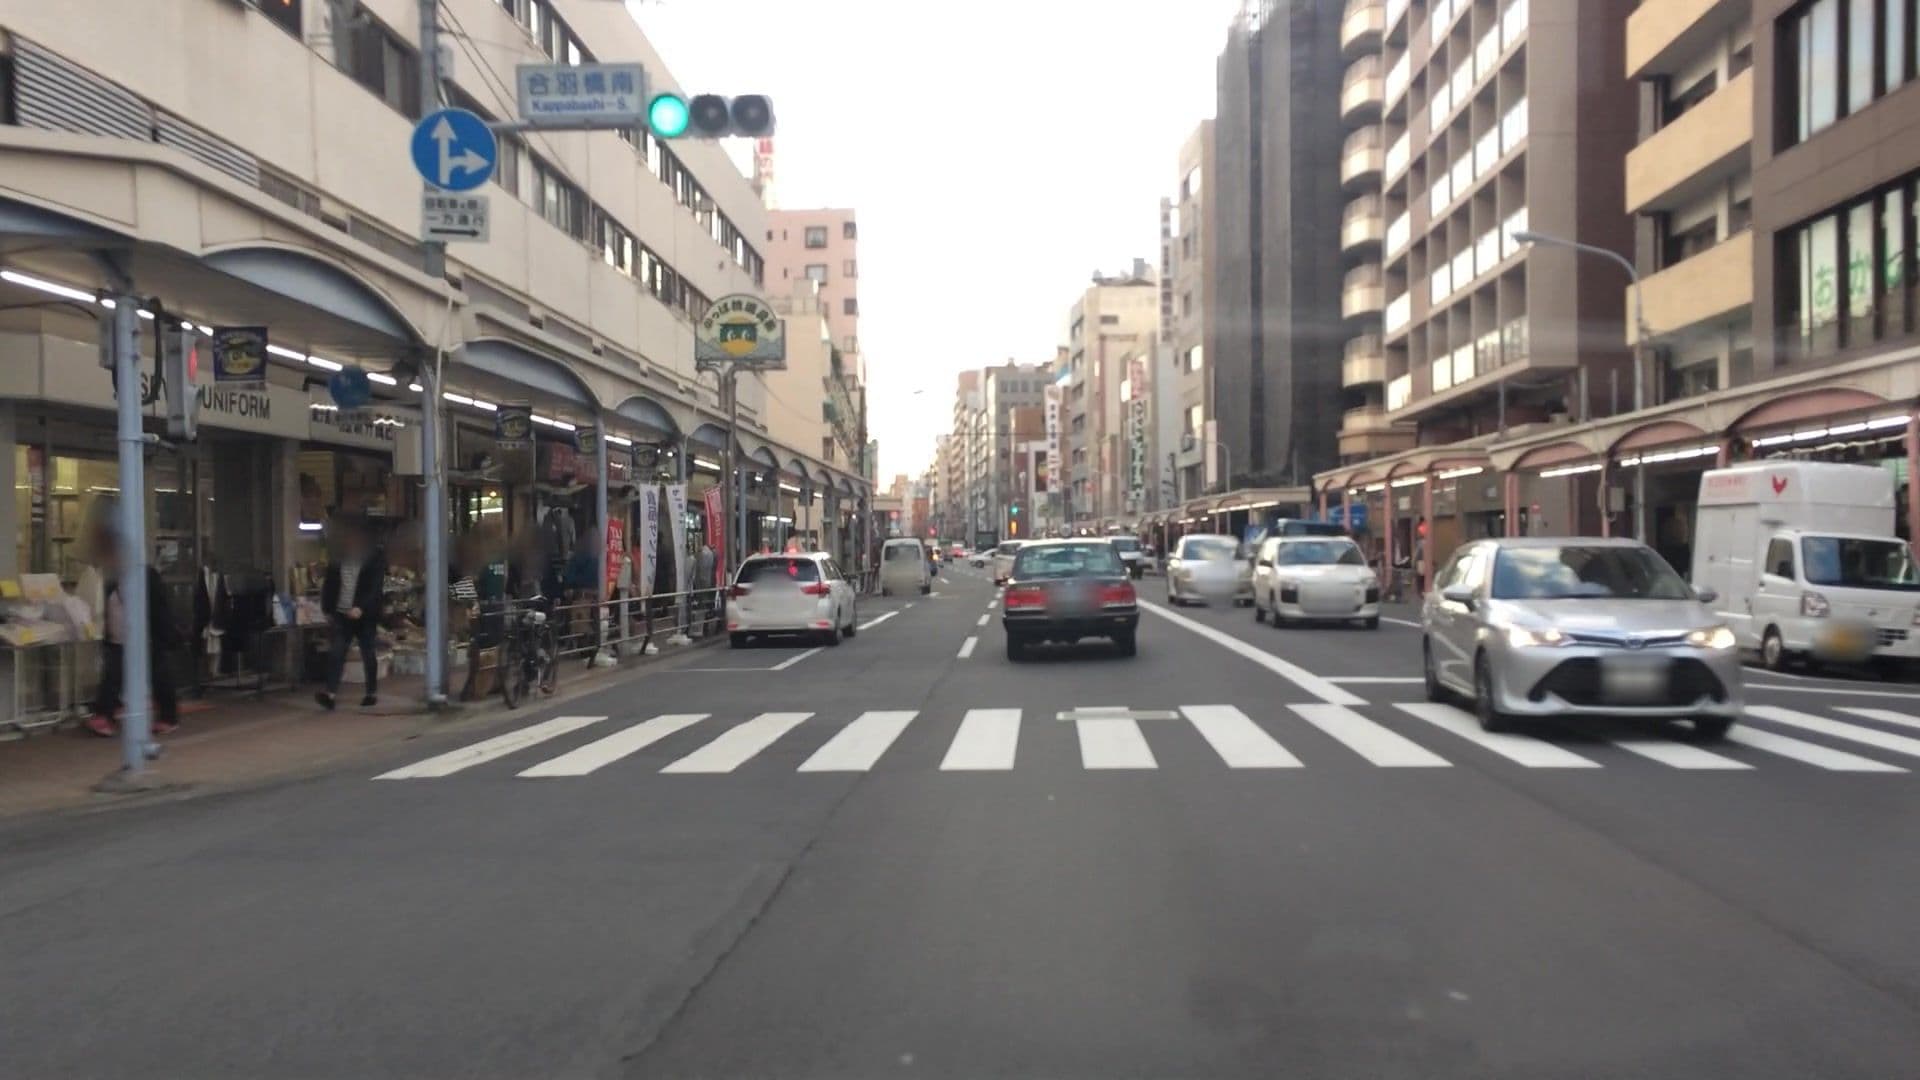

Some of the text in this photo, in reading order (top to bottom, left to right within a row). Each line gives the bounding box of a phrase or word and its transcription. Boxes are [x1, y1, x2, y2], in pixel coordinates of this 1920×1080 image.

[425, 213, 485, 227] 一方通行
[202, 384, 271, 420] UNIFORM
